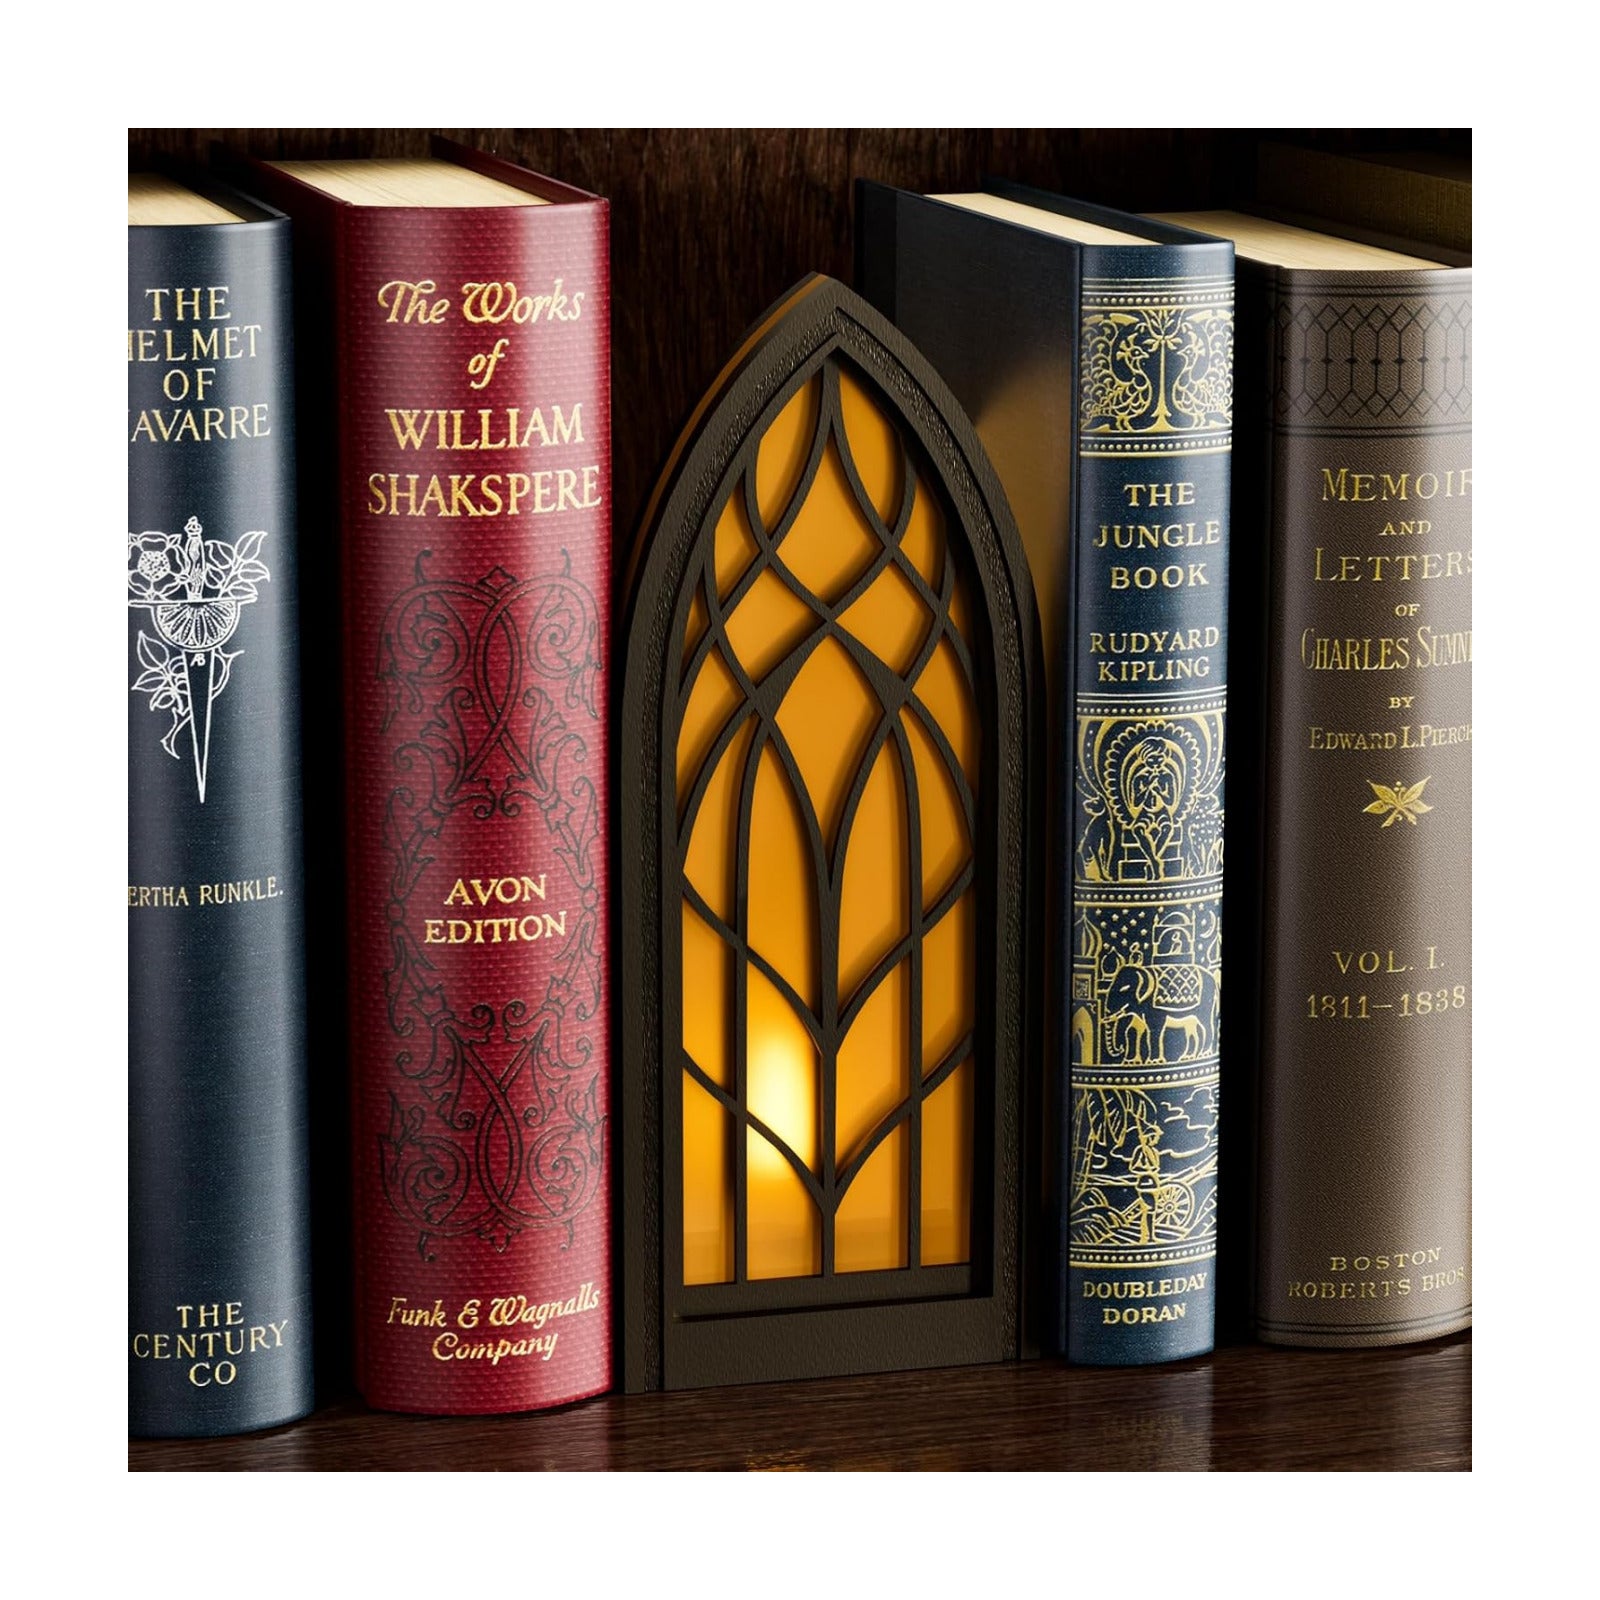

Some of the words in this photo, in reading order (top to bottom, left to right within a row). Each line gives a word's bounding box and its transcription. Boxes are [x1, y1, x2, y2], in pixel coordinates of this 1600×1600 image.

[145, 286, 232, 321] THE
[377, 280, 450, 324] The
[462, 278, 585, 325] Works
[468, 338, 510, 389] of
[163, 367, 216, 401] OF
[128, 403, 271, 442] AVARRE
[384, 403, 585, 450] WILLIAM
[368, 465, 602, 517] SHAKSPERE
[1123, 482, 1196, 507] THE
[1092, 520, 1221, 549] JUNGLE
[1377, 519, 1432, 536] AND
[1110, 563, 1210, 590] BOOK
[1395, 603, 1420, 617] OF
[1090, 626, 1220, 654] RUDYARD
[1301, 627, 1410, 671] CHARLES
[1098, 656, 1210, 682] KIPLING
[1388, 696, 1415, 709] BY
[1308, 726, 1397, 750] EDWARD
[200, 876, 284, 906] RUNKLE.
[443, 873, 547, 906] AVON
[424, 911, 567, 944] EDITION
[1332, 949, 1414, 975] VOL.
[1426, 945, 1445, 971] I.
[1330, 1247, 1442, 1272] BOSTON
[1082, 1272, 1208, 1299] DOUBLEDAY
[1288, 1279, 1412, 1299] ROBERTS
[176, 1301, 244, 1329] THE
[387, 1297, 447, 1327] Funk
[457, 1299, 481, 1329] &
[489, 1282, 600, 1329] Wagnalls
[1103, 1302, 1188, 1325] DORAN
[133, 1319, 288, 1359] CENTURY
[432, 1332, 558, 1366] Company
[188, 1360, 237, 1387] CO
